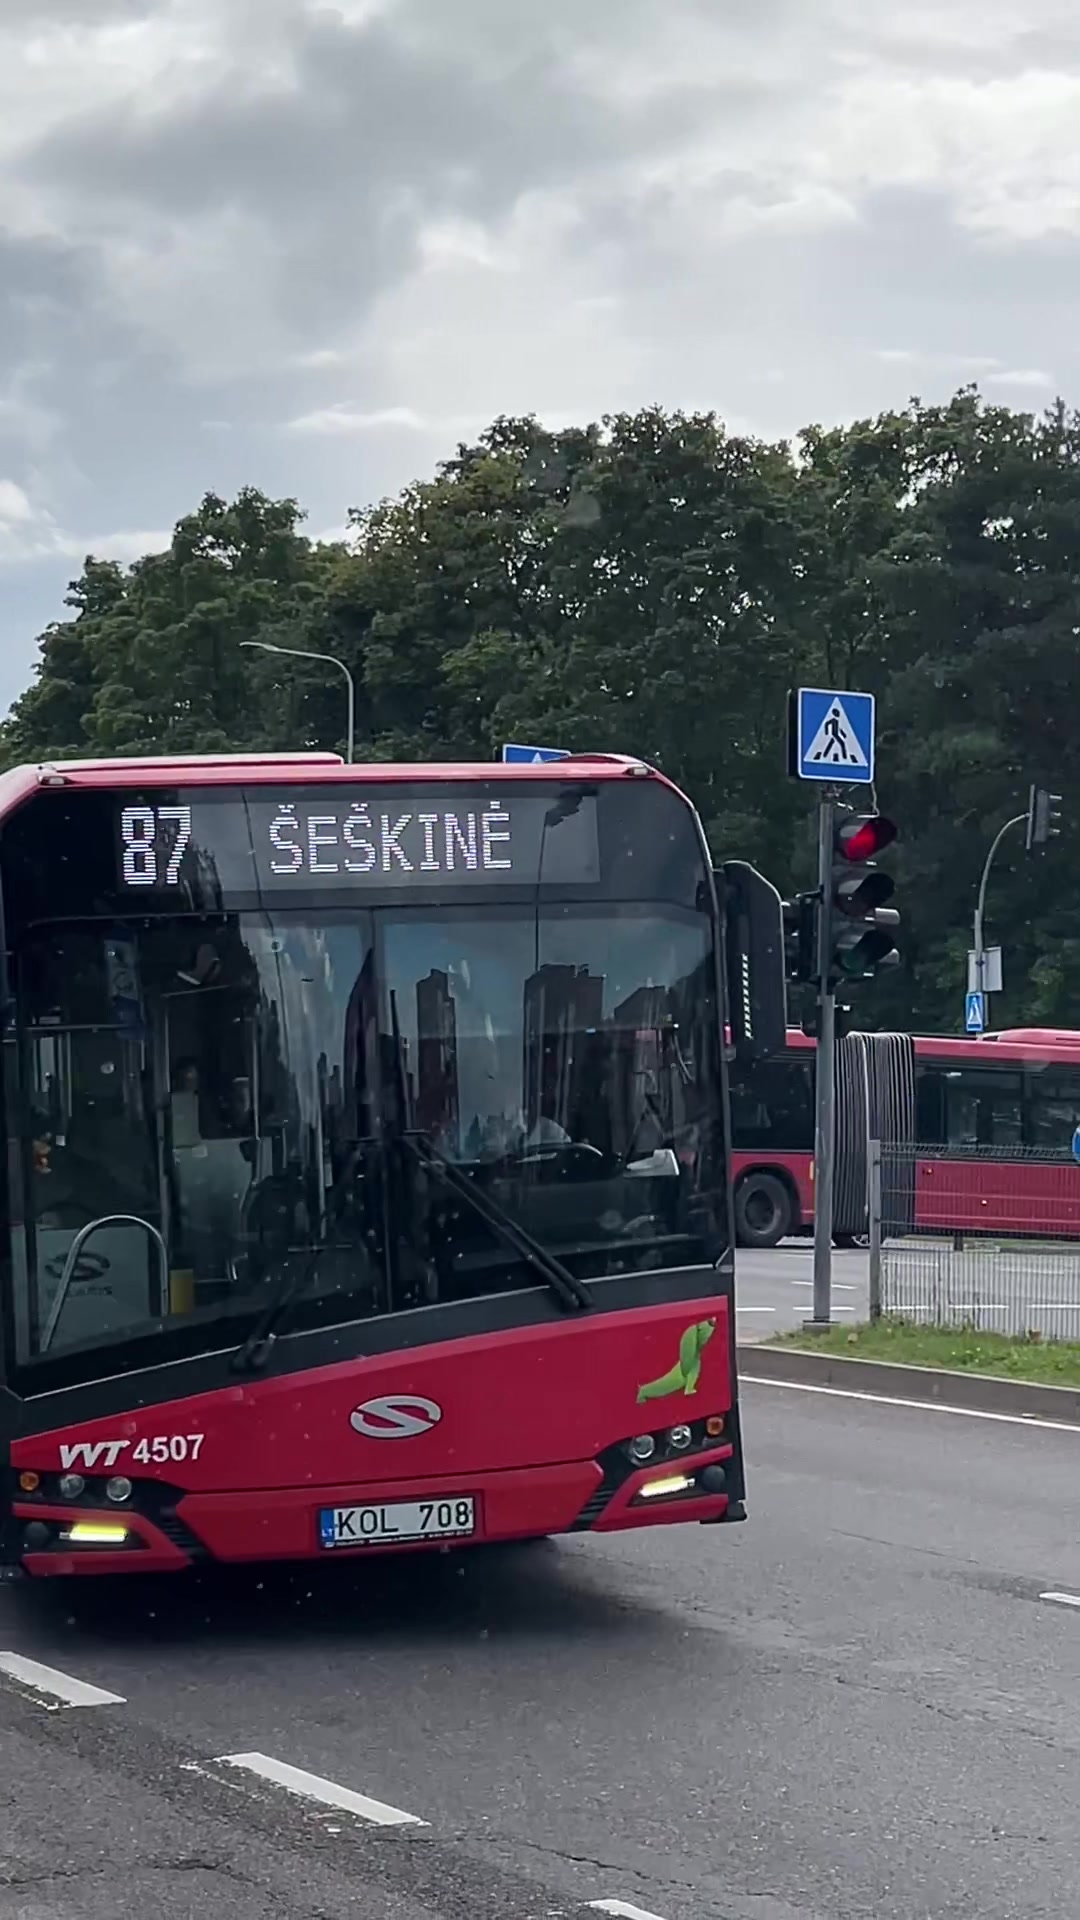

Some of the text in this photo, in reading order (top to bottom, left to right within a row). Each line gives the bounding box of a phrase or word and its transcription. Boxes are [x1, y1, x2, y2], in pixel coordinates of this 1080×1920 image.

[121, 801, 511, 884] 87 ŠEŠKINĖ
[132, 1434, 204, 1464] 4507
[338, 1501, 469, 1537] KOL 708
